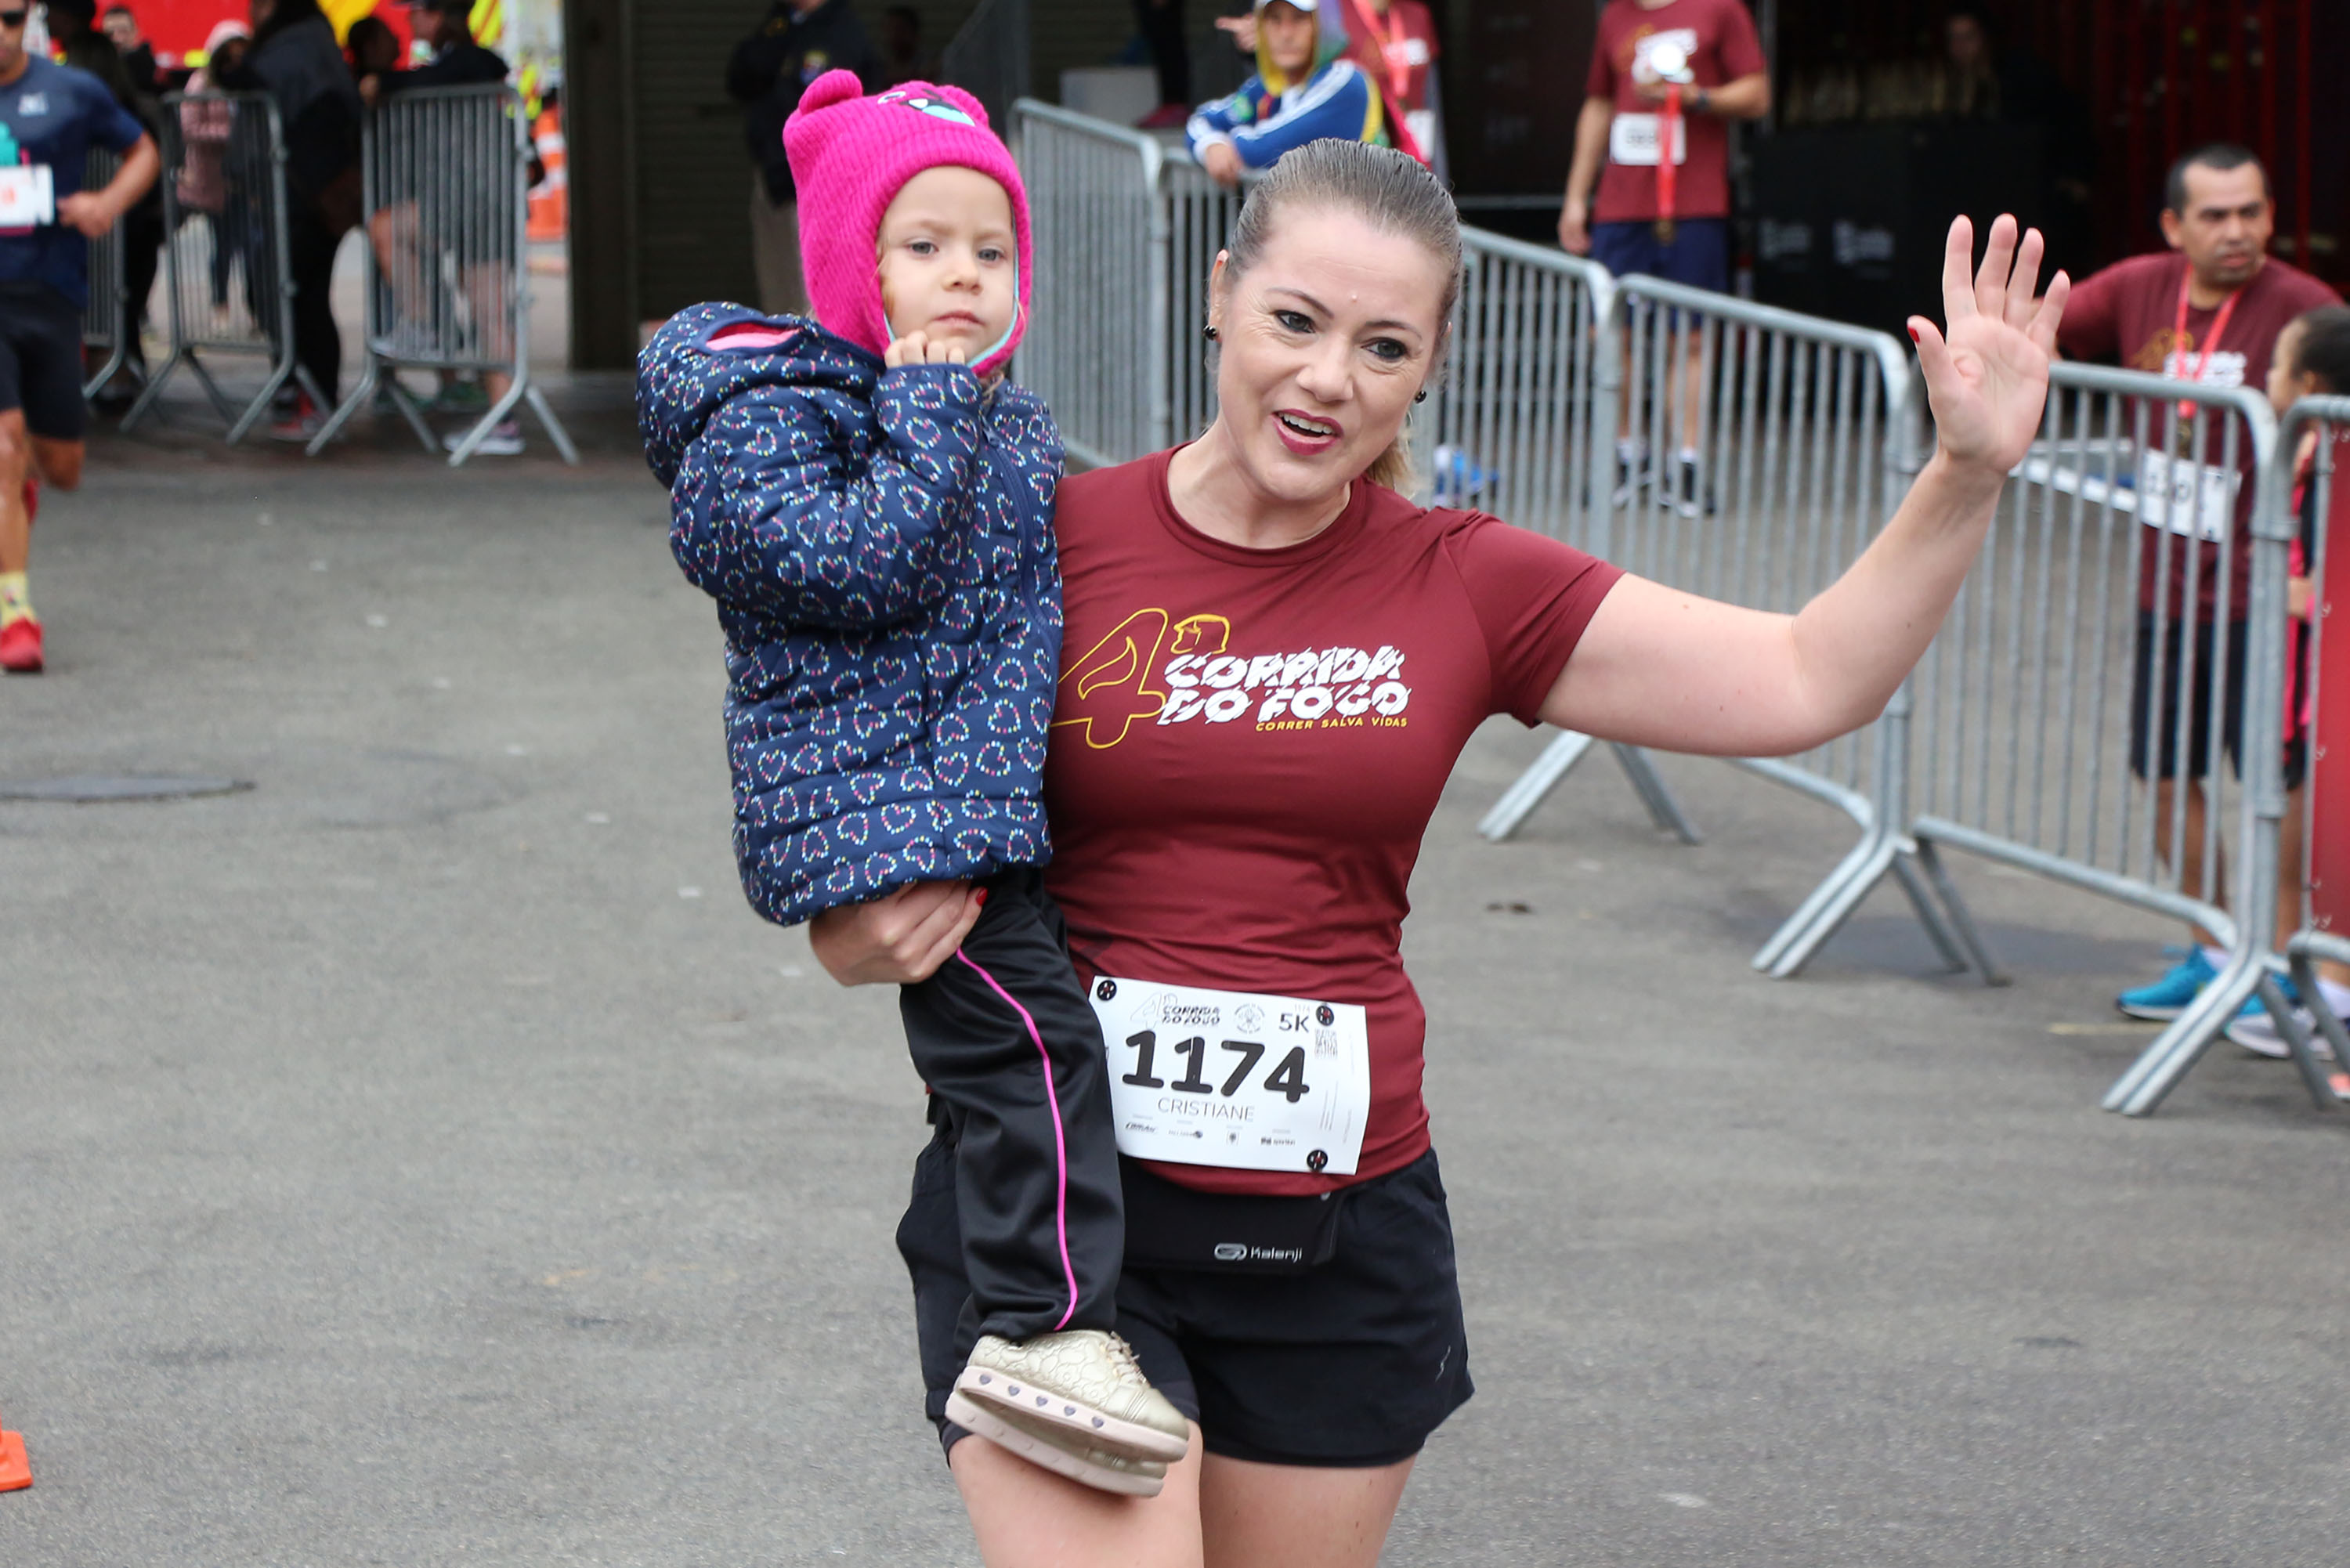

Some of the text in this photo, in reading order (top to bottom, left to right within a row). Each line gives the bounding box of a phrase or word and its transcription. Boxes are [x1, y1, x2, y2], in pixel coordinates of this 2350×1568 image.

[1163, 645, 1407, 690] CORRIDA
[1156, 680, 1412, 725] DO FOGO
[1255, 717, 1408, 732] CORRER SALVA VIDAS
[1279, 1013, 1310, 1033] 5K
[1122, 1029, 1311, 1104] 1174
[1158, 1097, 1254, 1122] CRISTIANE
[1250, 1246, 1303, 1263] Kalenji
